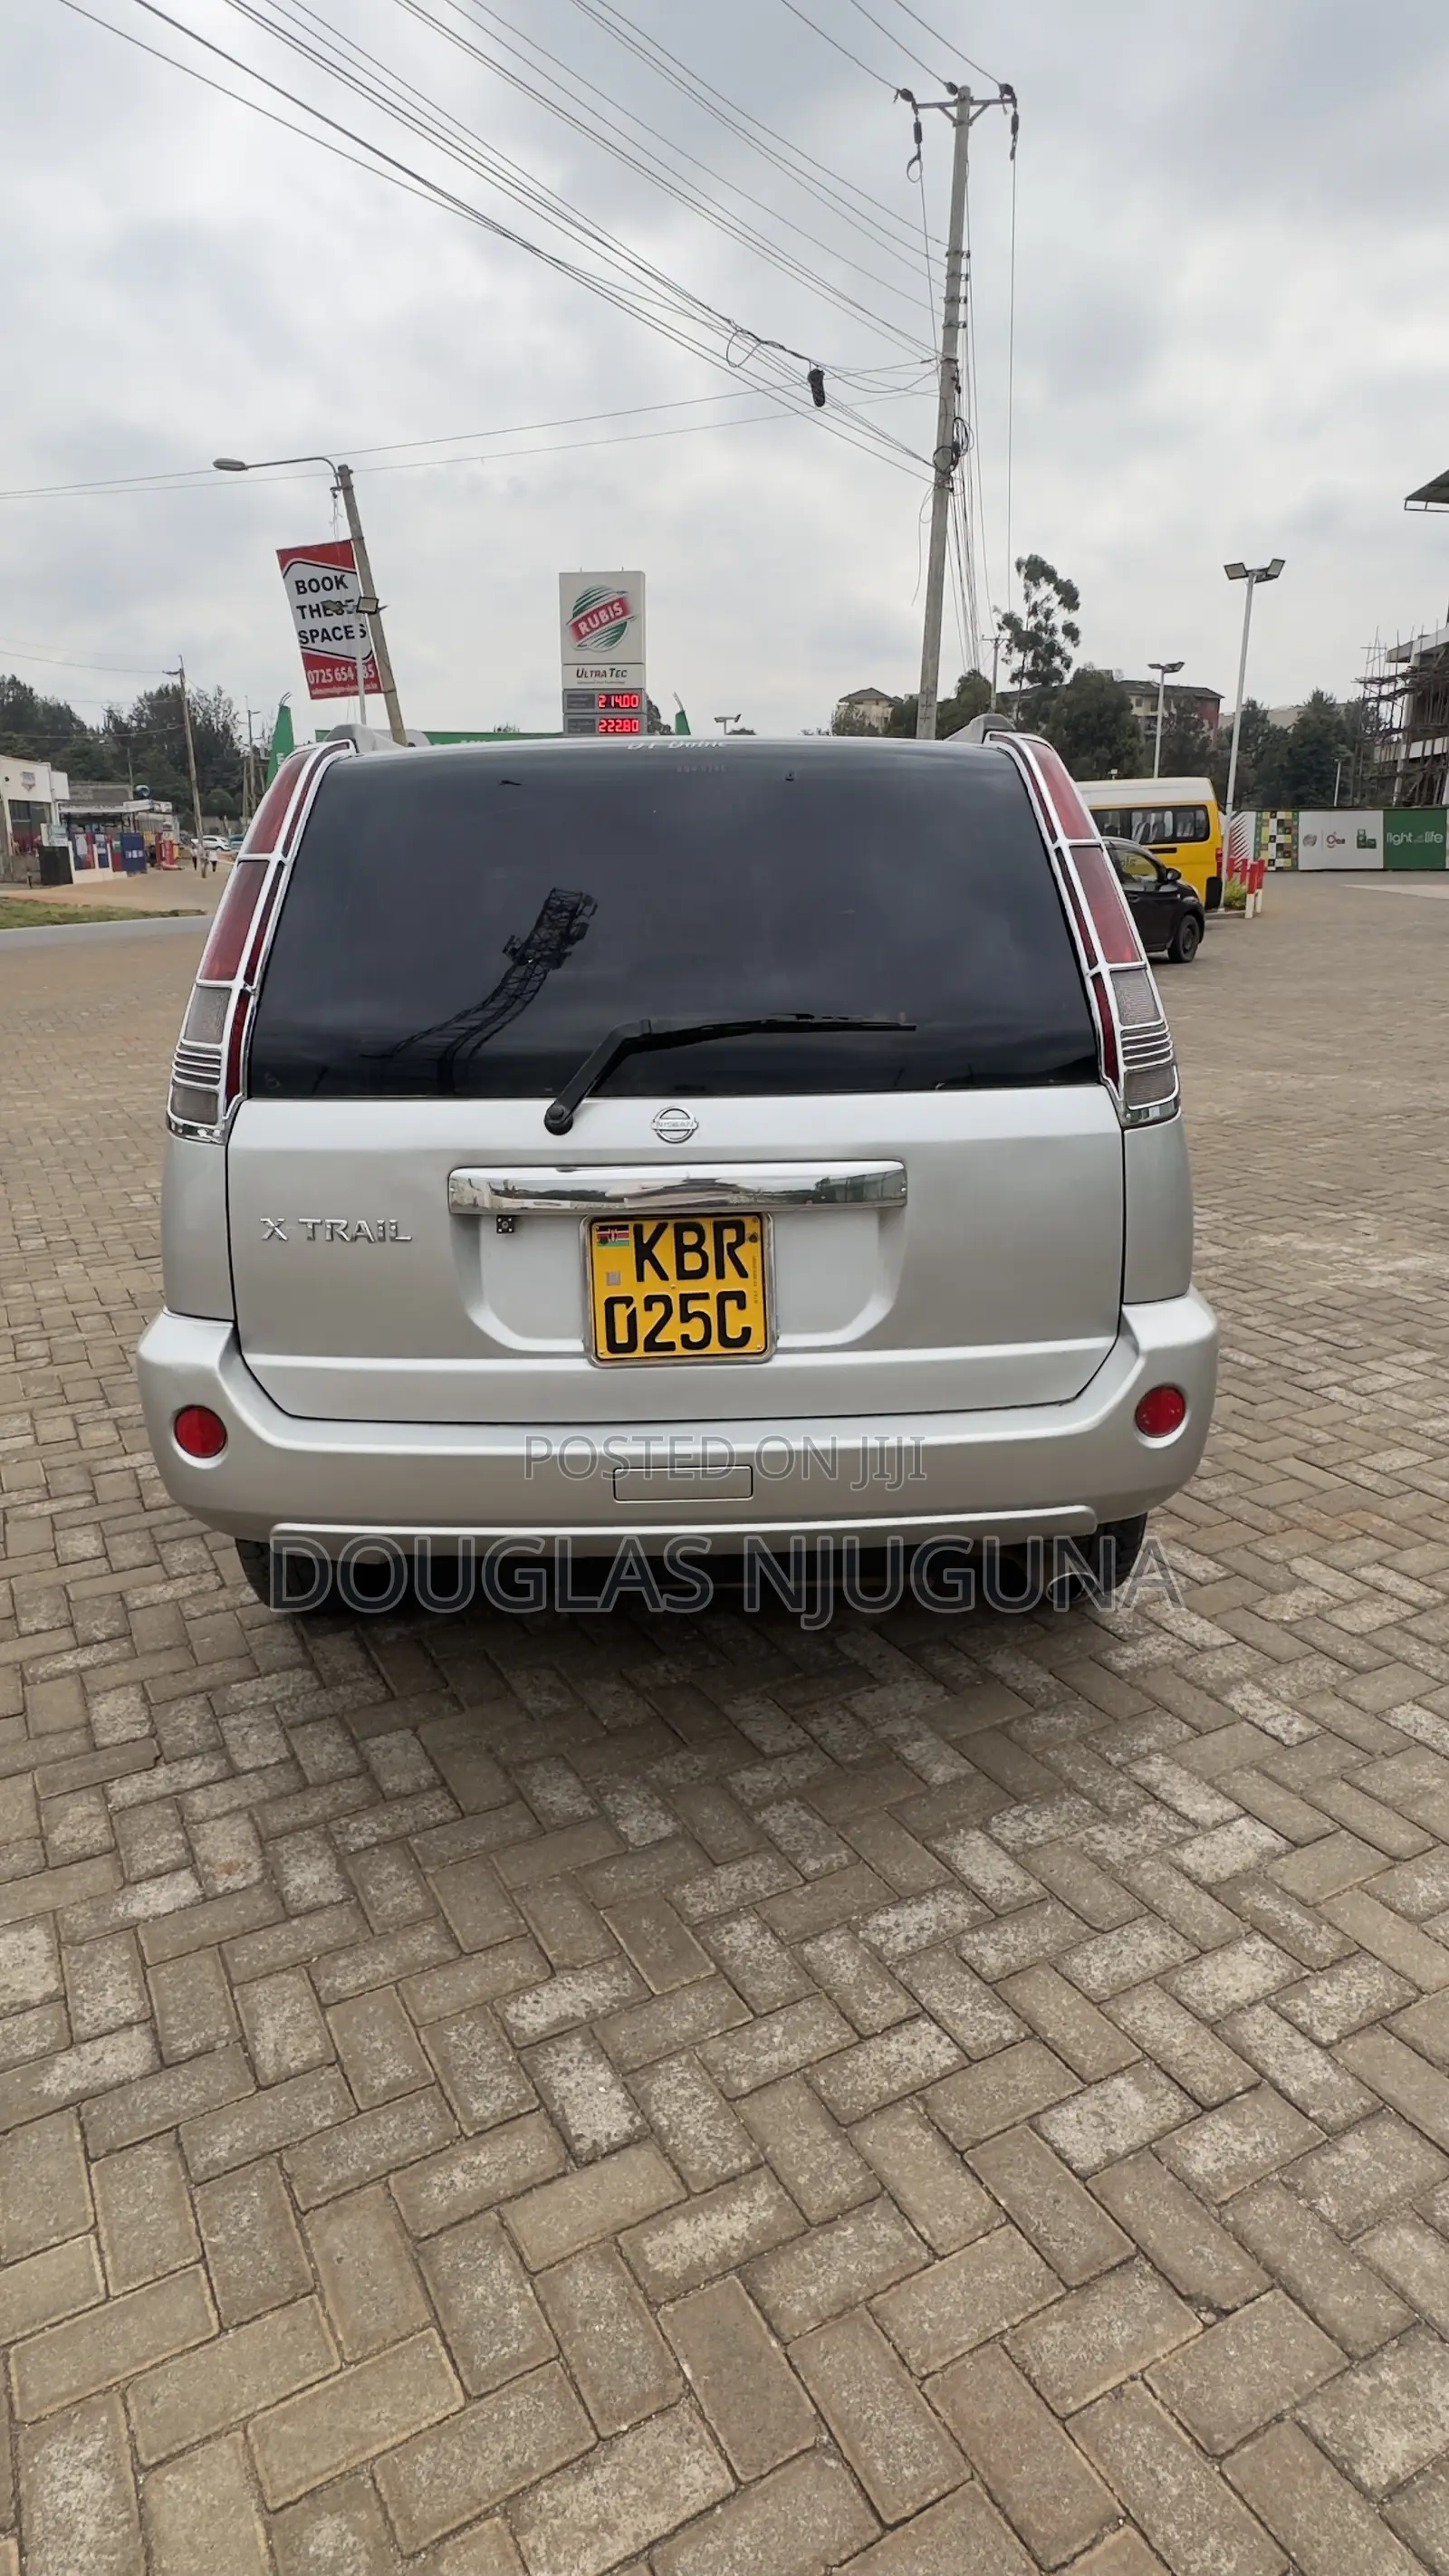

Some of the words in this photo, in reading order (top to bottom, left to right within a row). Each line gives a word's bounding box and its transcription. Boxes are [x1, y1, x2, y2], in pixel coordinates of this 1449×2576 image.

[294, 574, 350, 595] BOOK
[578, 602, 624, 636] RUBIS
[298, 623, 367, 645] SPACES
[307, 668, 333, 685] 0725
[334, 665, 354, 682] 654
[354, 663, 375, 679] 85
[1387, 832, 1413, 846] light
[298, 1218, 413, 1242] TRAIL
[634, 1220, 749, 1282] KBR
[604, 1290, 752, 1354] 025C
